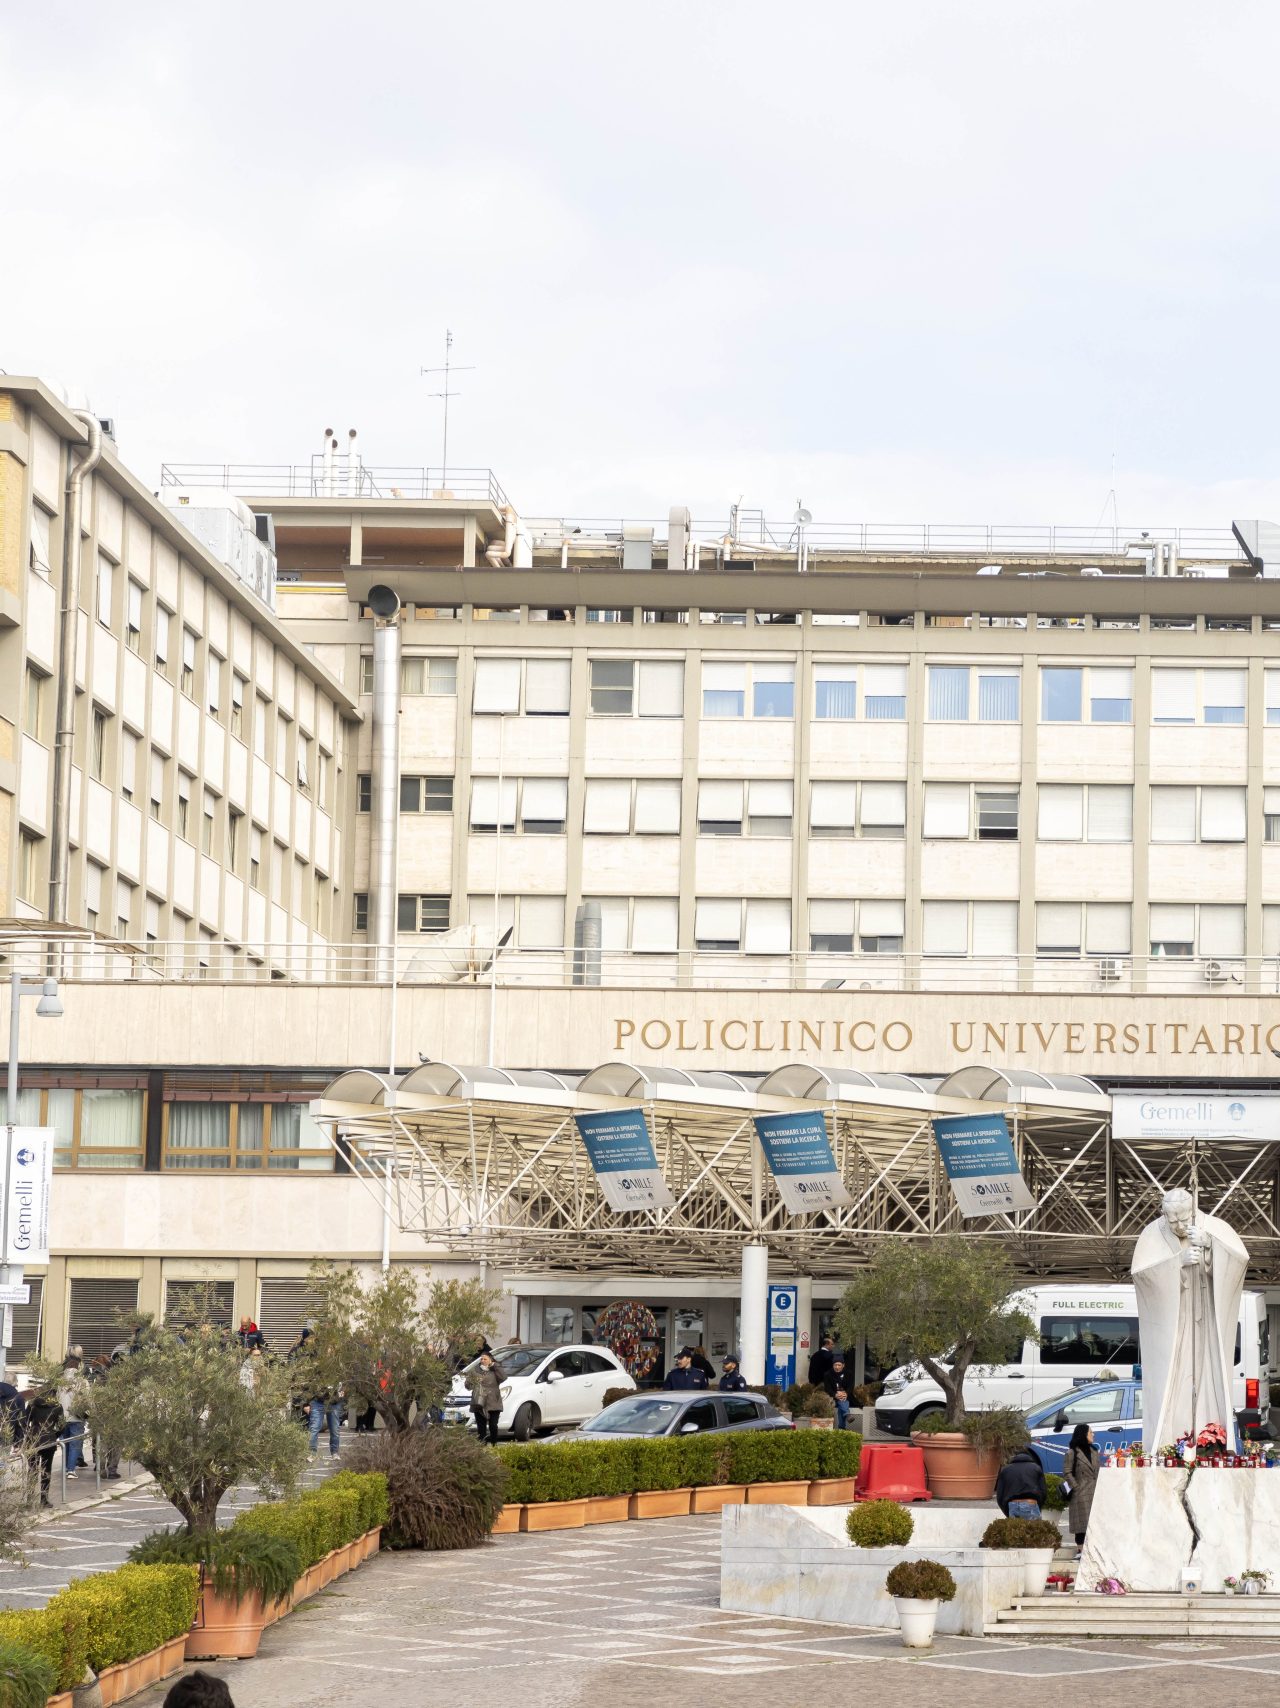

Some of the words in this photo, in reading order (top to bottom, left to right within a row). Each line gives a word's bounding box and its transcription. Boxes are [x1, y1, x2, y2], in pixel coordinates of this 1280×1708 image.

[613, 1018, 914, 1053] POLICLINICO
[1140, 1101, 1213, 1121] Gemelli
[13, 1181, 33, 1251] Gemelli
[780, 1296, 786, 1306] E
[1078, 1301, 1124, 1309] ELECTRIC
